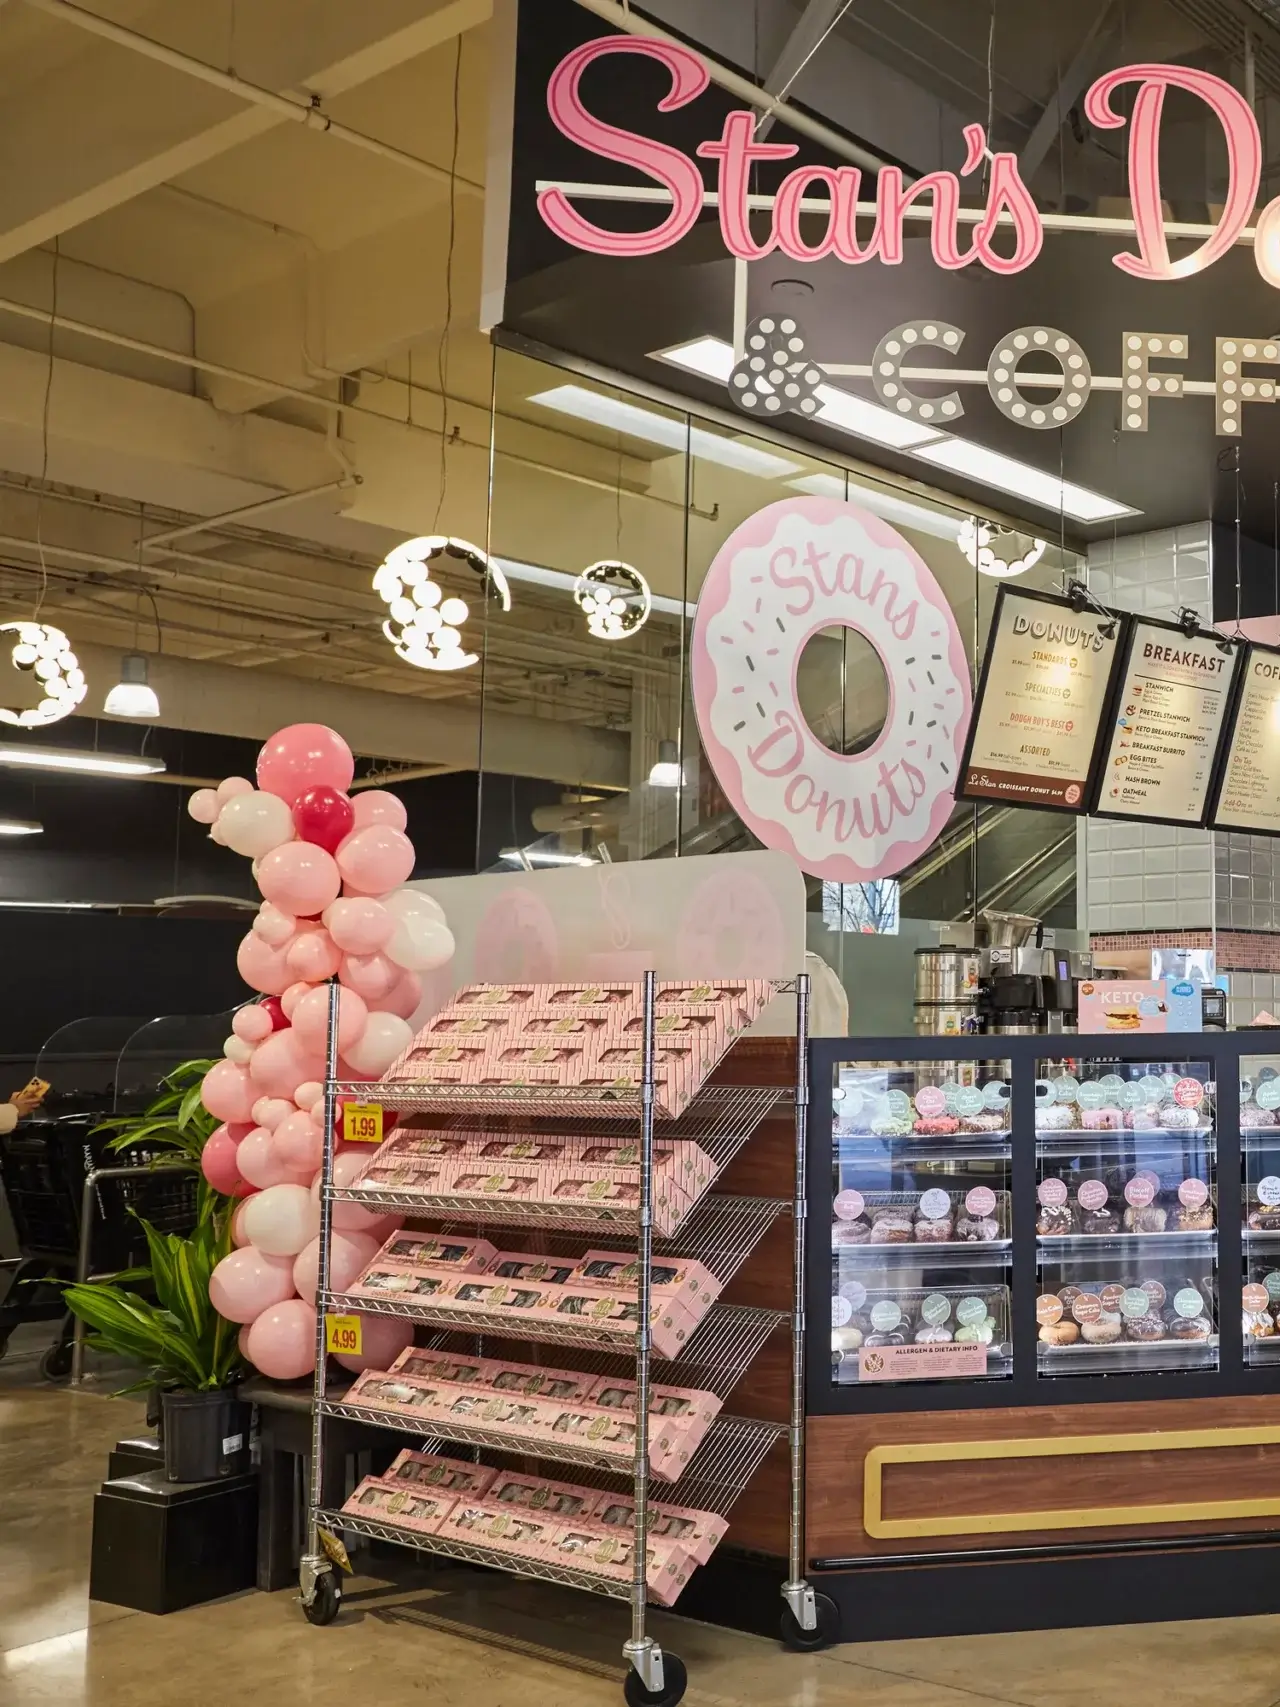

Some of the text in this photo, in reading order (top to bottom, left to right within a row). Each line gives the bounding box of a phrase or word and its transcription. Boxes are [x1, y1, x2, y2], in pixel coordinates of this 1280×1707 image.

[537, 34, 1044, 275] Stan's
[728, 313, 829, 420] &
[1012, 615, 1105, 653] DONUTS
[1143, 643, 1225, 673] BREAKFAST
[1139, 708, 1162, 719] PRETZEL
[1010, 712, 1032, 724] DOUGH
[1051, 719, 1065, 729] BEST
[1135, 725, 1151, 733] KETO
[1151, 728, 1180, 738] BREAKFAST
[1020, 744, 1051, 757] ASSORTED
[1131, 742, 1186, 756] BREAKFAST BURRITO
[1142, 755, 1157, 764] BITES
[747, 710, 926, 843] Donuts
[1125, 775, 1161, 786] HASH BROWN
[999, 783, 1030, 792] CROISSANT
[1030, 787, 1049, 795] DONUT
[1122, 788, 1147, 797] OATMEAL
[1101, 991, 1145, 1004] KETO
[350, 1116, 376, 1137] 1.99
[568, 1316, 600, 1326] CHOCOLATE
[332, 1334, 357, 1350] 4.99
